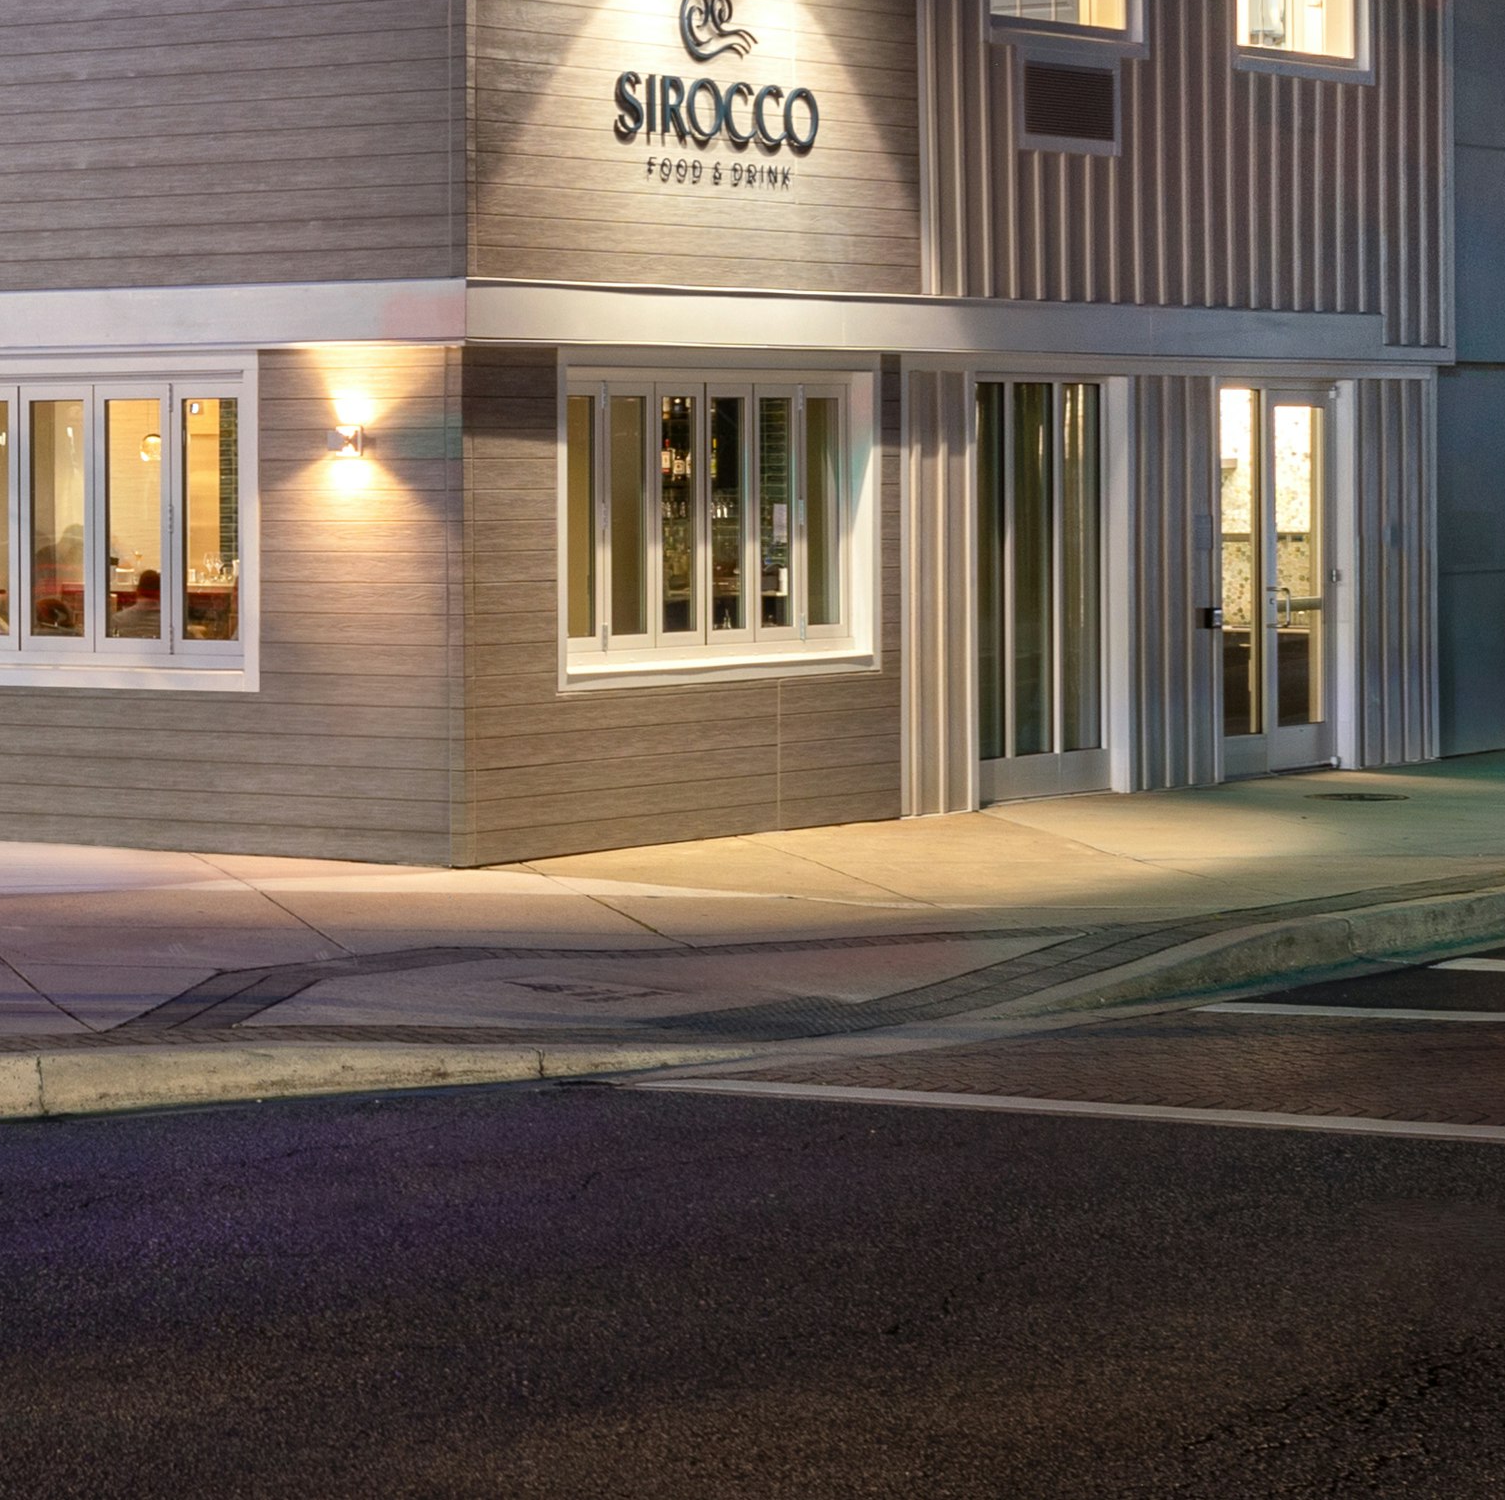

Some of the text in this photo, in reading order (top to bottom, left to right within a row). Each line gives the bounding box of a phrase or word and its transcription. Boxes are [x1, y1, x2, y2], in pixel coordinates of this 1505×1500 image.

[613, 70, 820, 152] SIROCCO
[647, 156, 792, 188] FOOD & DRINK
